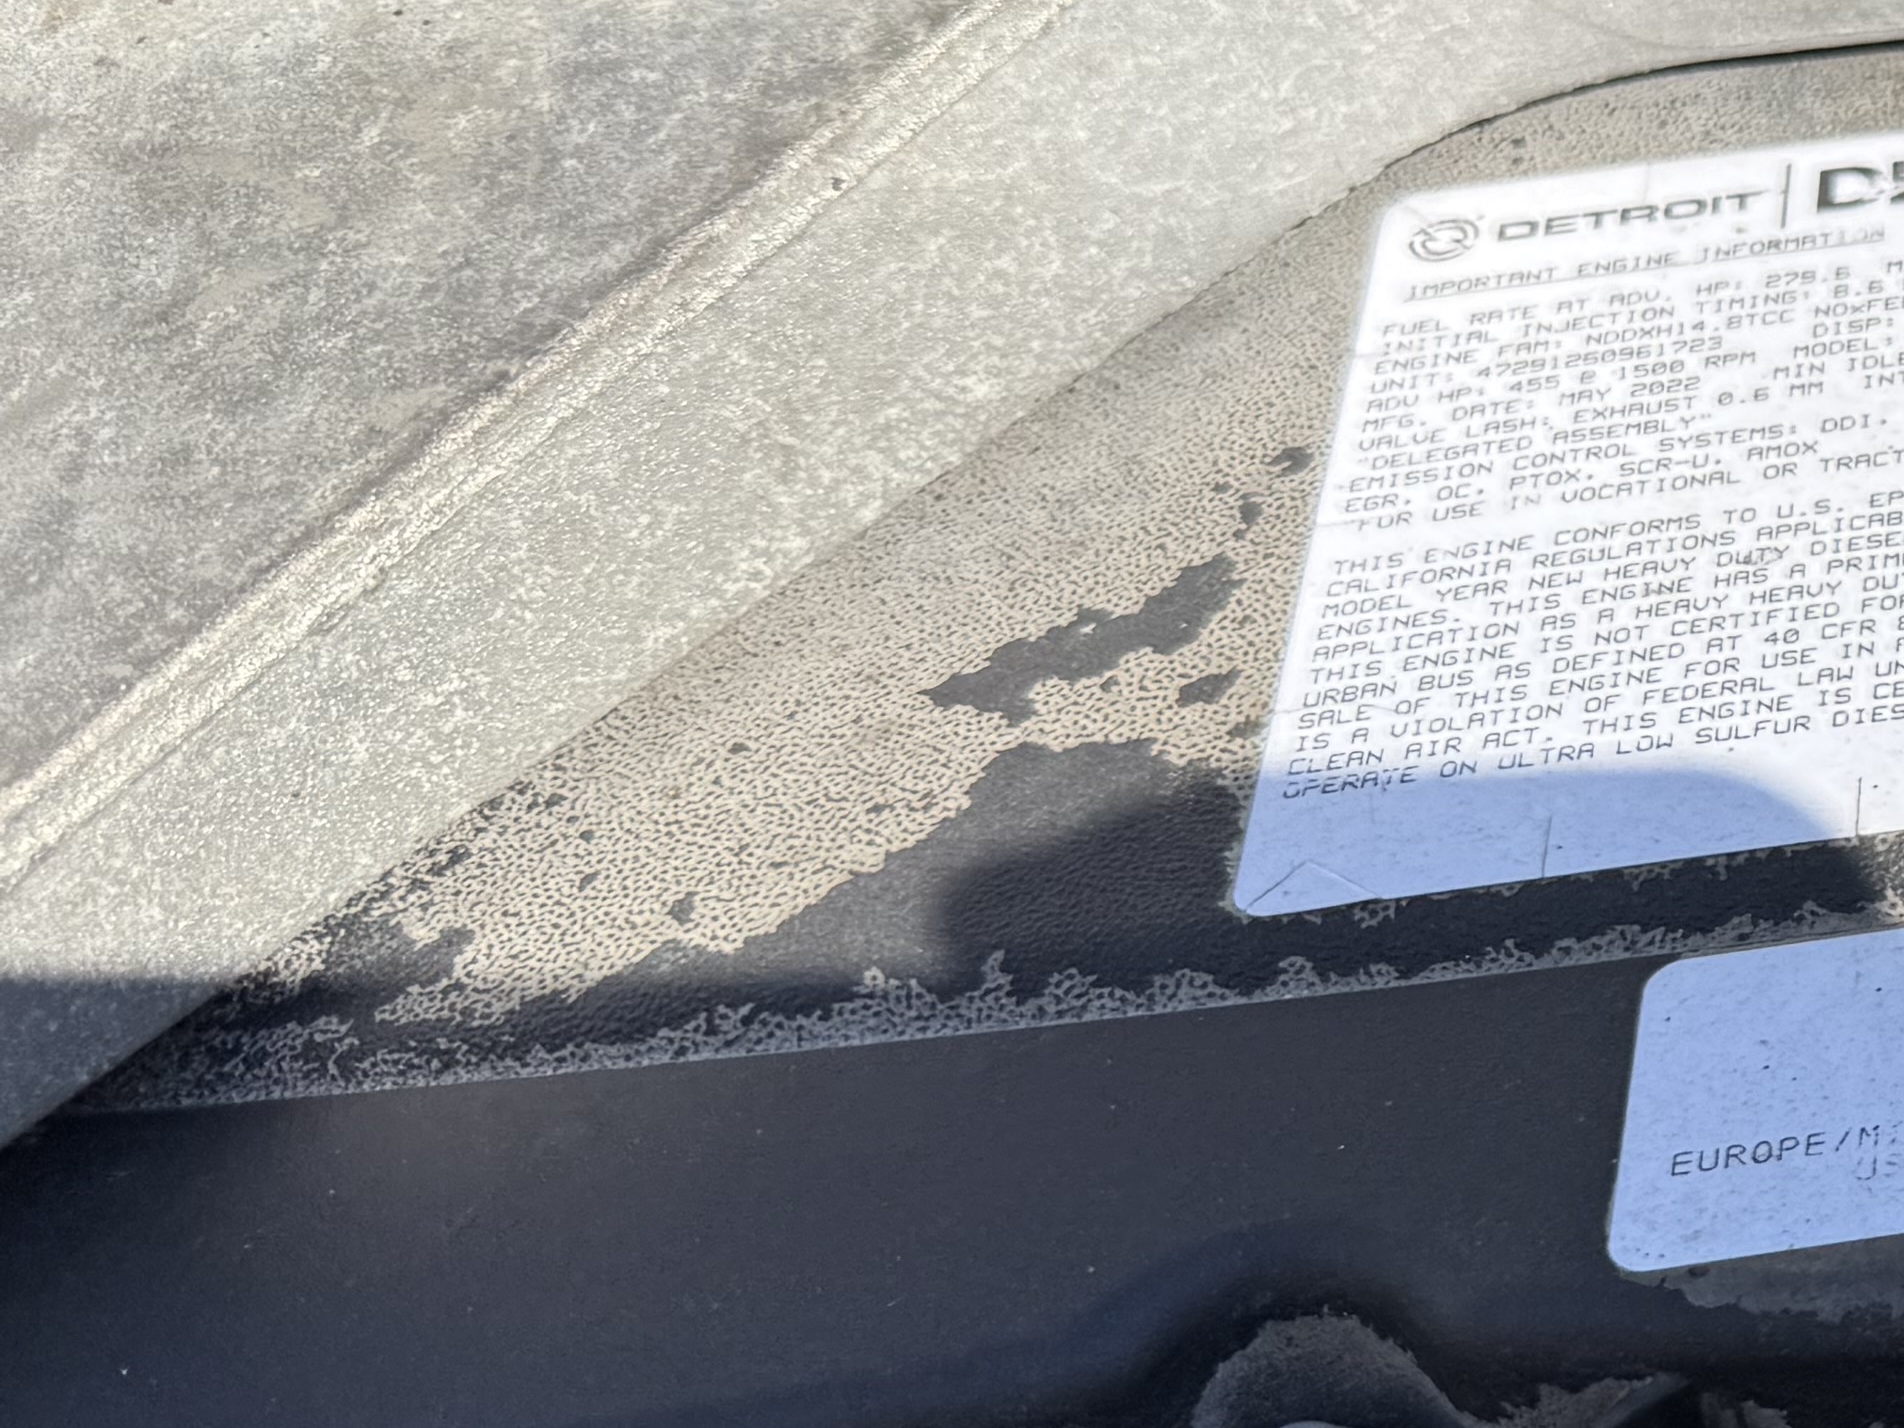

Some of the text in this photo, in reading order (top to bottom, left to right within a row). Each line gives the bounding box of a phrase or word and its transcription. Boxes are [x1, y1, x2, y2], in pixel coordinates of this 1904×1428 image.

[1497, 190, 1771, 243] DETROIT
[1407, 249, 1681, 300] IMPORTANT ENGINE
[1382, 298, 1589, 337] FUEL RATE AT
[1522, 305, 1674, 339] INJECTION
[1811, 316, 1894, 340] DISP:
[1374, 348, 1478, 376] ENGINE
[1451, 398, 1534, 422] DATE:
[1558, 387, 1611, 407] MAY
[1629, 376, 1700, 398] 2022
[1772, 361, 1825, 381] MIN
[1507, 374, 1560, 394] 455
[1618, 359, 1684, 381] 1500
[1703, 351, 1755, 370] RPM
[1792, 336, 1893, 359] MODEL:
[1572, 395, 1698, 425] EXHAUST
[1717, 386, 1769, 407] 0.6
[1788, 381, 1823, 398] MM
[1348, 423, 1797, 494] EMISSION CONTROL SYSTEMS:
[1746, 439, 1817, 462] AMOX
[1431, 500, 1485, 523] USE
[1559, 470, 1741, 504] VOCATIONAL
[1762, 461, 1797, 481] OR
[1325, 557, 1512, 598] CALIFORNIA
[1531, 529, 1735, 570] REGULATIONS
[1333, 552, 1404, 576] THIS
[1423, 534, 1535, 564] ENGINE
[1553, 513, 1701, 547] CONFORMS
[1722, 507, 1756, 525] TO
[1775, 498, 1844, 520] U.S.
[1316, 608, 1461, 641] ENGINES.
[1488, 593, 1561, 617] THIS
[1581, 576, 1692, 606] ENGINE
[1713, 567, 1767, 589] HAS
[1784, 562, 1805, 580] A
[1321, 594, 1412, 619] MODEL
[1435, 579, 1508, 603] YEAR
[1527, 569, 1583, 592] NEW
[1602, 556, 1695, 582] HEAVY
[1309, 659, 1383, 685] THIS
[1401, 641, 1516, 673] ENGINE
[1539, 634, 1573, 654] IS
[1593, 625, 1649, 647] NOT
[1669, 601, 1838, 637] CERTIFIED
[1311, 620, 1520, 663] APPLICATION
[1539, 612, 1577, 632] AS
[1596, 607, 1614, 625] A
[1634, 593, 1728, 620] HEAVY
[1748, 580, 1841, 606] HEAVY
[1297, 703, 1375, 730] SALE
[1392, 696, 1431, 716] OF
[1453, 683, 1528, 709] THIS
[1547, 666, 1662, 697] ENGINE
[1683, 656, 1739, 680] FOR
[1760, 647, 1816, 670] USE
[1840, 641, 1873, 660] IN
[1301, 680, 1398, 710] URBAN
[1416, 669, 1474, 693] BUS
[1494, 661, 1532, 682] AS
[1551, 642, 1684, 675] DEFINED
[1705, 635, 1741, 655] AT
[1762, 628, 1799, 646] 40
[1820, 618, 1875, 641] CFR
[1286, 748, 1385, 777] CLEAN
[1403, 736, 1462, 760] AIR
[1481, 726, 1553, 750] ACT.
[1581, 711, 1656, 736] THIS
[1677, 693, 1792, 725] ENGINE
[1817, 686, 1850, 708] IS
[1294, 731, 1332, 753] IS
[1350, 727, 1370, 745] A
[1389, 701, 1563, 739] VIOLATION
[1583, 693, 1621, 714] OF
[1640, 676, 1774, 707] FEDERAL
[1796, 665, 1852, 688] LAW
[1439, 760, 1478, 779] ON
[1497, 742, 1595, 770] ULTRA
[1615, 732, 1673, 756] LOW
[1694, 714, 1809, 745] SULFUR
